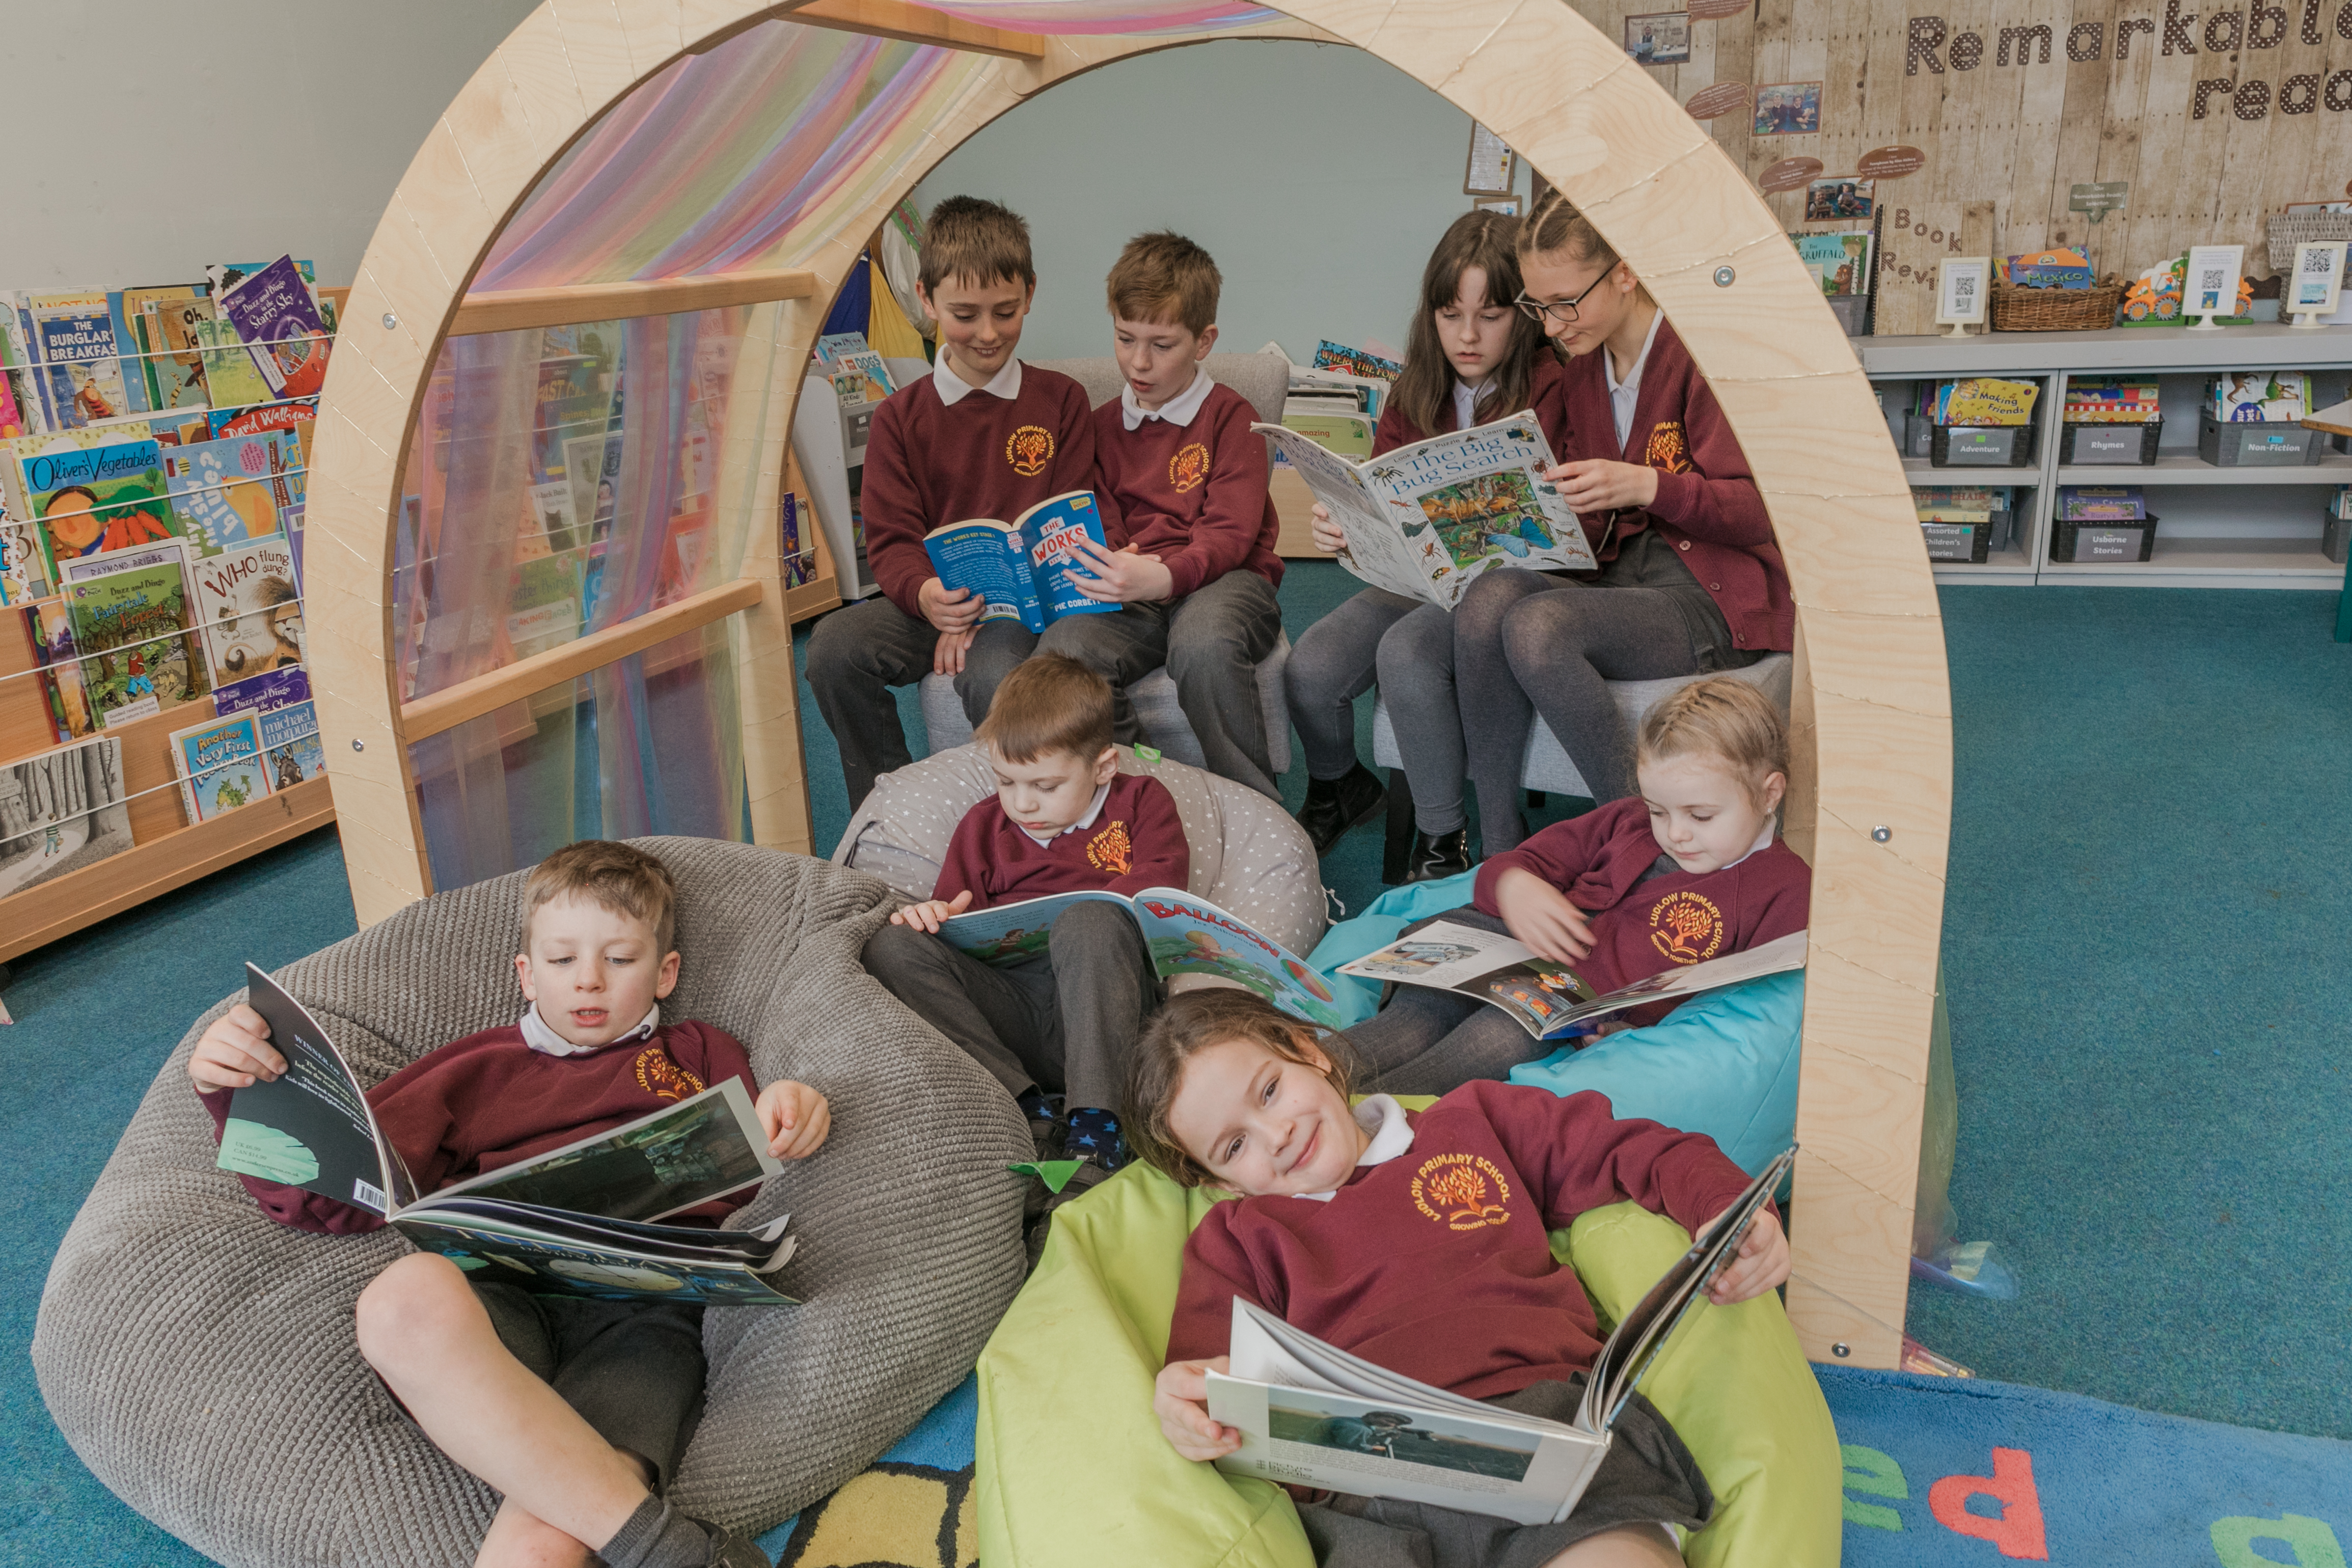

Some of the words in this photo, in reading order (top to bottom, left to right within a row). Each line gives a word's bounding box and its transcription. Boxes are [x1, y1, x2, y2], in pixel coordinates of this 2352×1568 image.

[1895, 209, 1962, 252] Book
[1800, 250, 1845, 260] GRUFFALO
[1881, 252, 1936, 291] Revi
[242, 299, 260, 314] Buzz
[259, 290, 270, 304] and
[268, 280, 286, 295] Bingo
[266, 300, 275, 310] the
[249, 307, 278, 329] Starry
[276, 293, 294, 311] Sky
[74, 321, 93, 331] THE
[49, 330, 113, 347] BURGLAR'
[50, 343, 117, 361] BREAKFAS
[855, 355, 881, 369] DOGS
[1321, 350, 1354, 368] WHERE
[1356, 360, 1376, 374] THE
[537, 379, 565, 403] FAST
[1979, 392, 2018, 407] Making
[1987, 404, 2025, 415] Friends
[224, 414, 260, 438] David
[260, 407, 313, 426] Walliams
[1297, 429, 1330, 438] amazing
[1006, 433, 1017, 464] LUDLOW
[1017, 425, 1048, 435] PRIMARY
[1046, 432, 1055, 459] SCHOOL
[1393, 453, 1412, 463] Look
[1435, 437, 1461, 449] Puzzle
[1482, 427, 1504, 437] Learn
[1406, 450, 1457, 472] The
[1460, 437, 1503, 457] Big
[2091, 441, 2125, 450] Rhymes
[2248, 444, 2301, 452] Non-Fiction
[32, 457, 90, 491] Oliver's
[85, 446, 157, 482] Vegetables
[1169, 455, 1179, 484] LUDLOW
[1200, 445, 1210, 473] SCHOOL
[1391, 467, 1443, 496] Bug
[1445, 446, 1534, 476] Search
[1433, 476, 1459, 488] Illustrated
[1477, 465, 1500, 476] Jackson
[1912, 492, 1948, 501] ETER'S
[1950, 492, 1986, 501] CHAIR
[204, 517, 218, 547] the
[952, 533, 970, 542] WORKS
[1044, 520, 1060, 533] THE
[186, 521, 203, 561] Why
[1034, 527, 1084, 562] WORKS
[91, 562, 129, 576] RAYMOND
[132, 555, 163, 568] BRIGGS
[204, 556, 258, 598] WHO
[259, 549, 289, 566] flung
[262, 564, 288, 576] dung?
[111, 587, 130, 596] Buzz
[131, 582, 144, 591] and
[145, 579, 166, 589] Bingo
[92, 591, 149, 621] Fairytale
[119, 601, 166, 628] Forest
[1054, 601, 1067, 612] PIE
[1068, 597, 1101, 609] CORBETT
[234, 698, 254, 709] Buzz
[255, 691, 268, 703] and
[268, 686, 291, 698] Bingo
[260, 701, 269, 711] the
[108, 710, 126, 719] Guided
[126, 704, 144, 713] reading
[264, 707, 311, 734] michael
[198, 729, 243, 753] Another
[293, 741, 305, 753] Mr
[196, 747, 224, 768] Very
[225, 741, 251, 754] First
[1142, 901, 1280, 958] BALLOON
[1650, 892, 1678, 927] LUDLOW
[1681, 891, 1721, 918] PRIMARY
[1701, 921, 1723, 958] SCHOOL
[1213, 925, 1260, 950] Alborough
[1651, 934, 1670, 956] GROWING
[1669, 953, 1698, 965] TOGETHER
[294, 1034, 329, 1065] WINNER
[330, 1064, 341, 1076] OF
[294, 1060, 313, 1076] before
[313, 1073, 323, 1083] the
[322, 1080, 339, 1093] reader
[636, 1053, 651, 1091] LUDLOW
[285, 1074, 297, 1085] Kids
[297, 1081, 308, 1090] will
[307, 1085, 318, 1096] love
[315, 1083, 327, 1095] book
[233, 1148, 248, 1156] CAN
[248, 1151, 267, 1161] $14.99
[1418, 1153, 1474, 1179] PRIMARY
[232, 1156, 299, 1178] www.andersenpress.co.uk
[1475, 1156, 1511, 1203] SCHOOL
[1411, 1176, 1442, 1222] LUDLOW
[1449, 1220, 1487, 1231] GROWING
